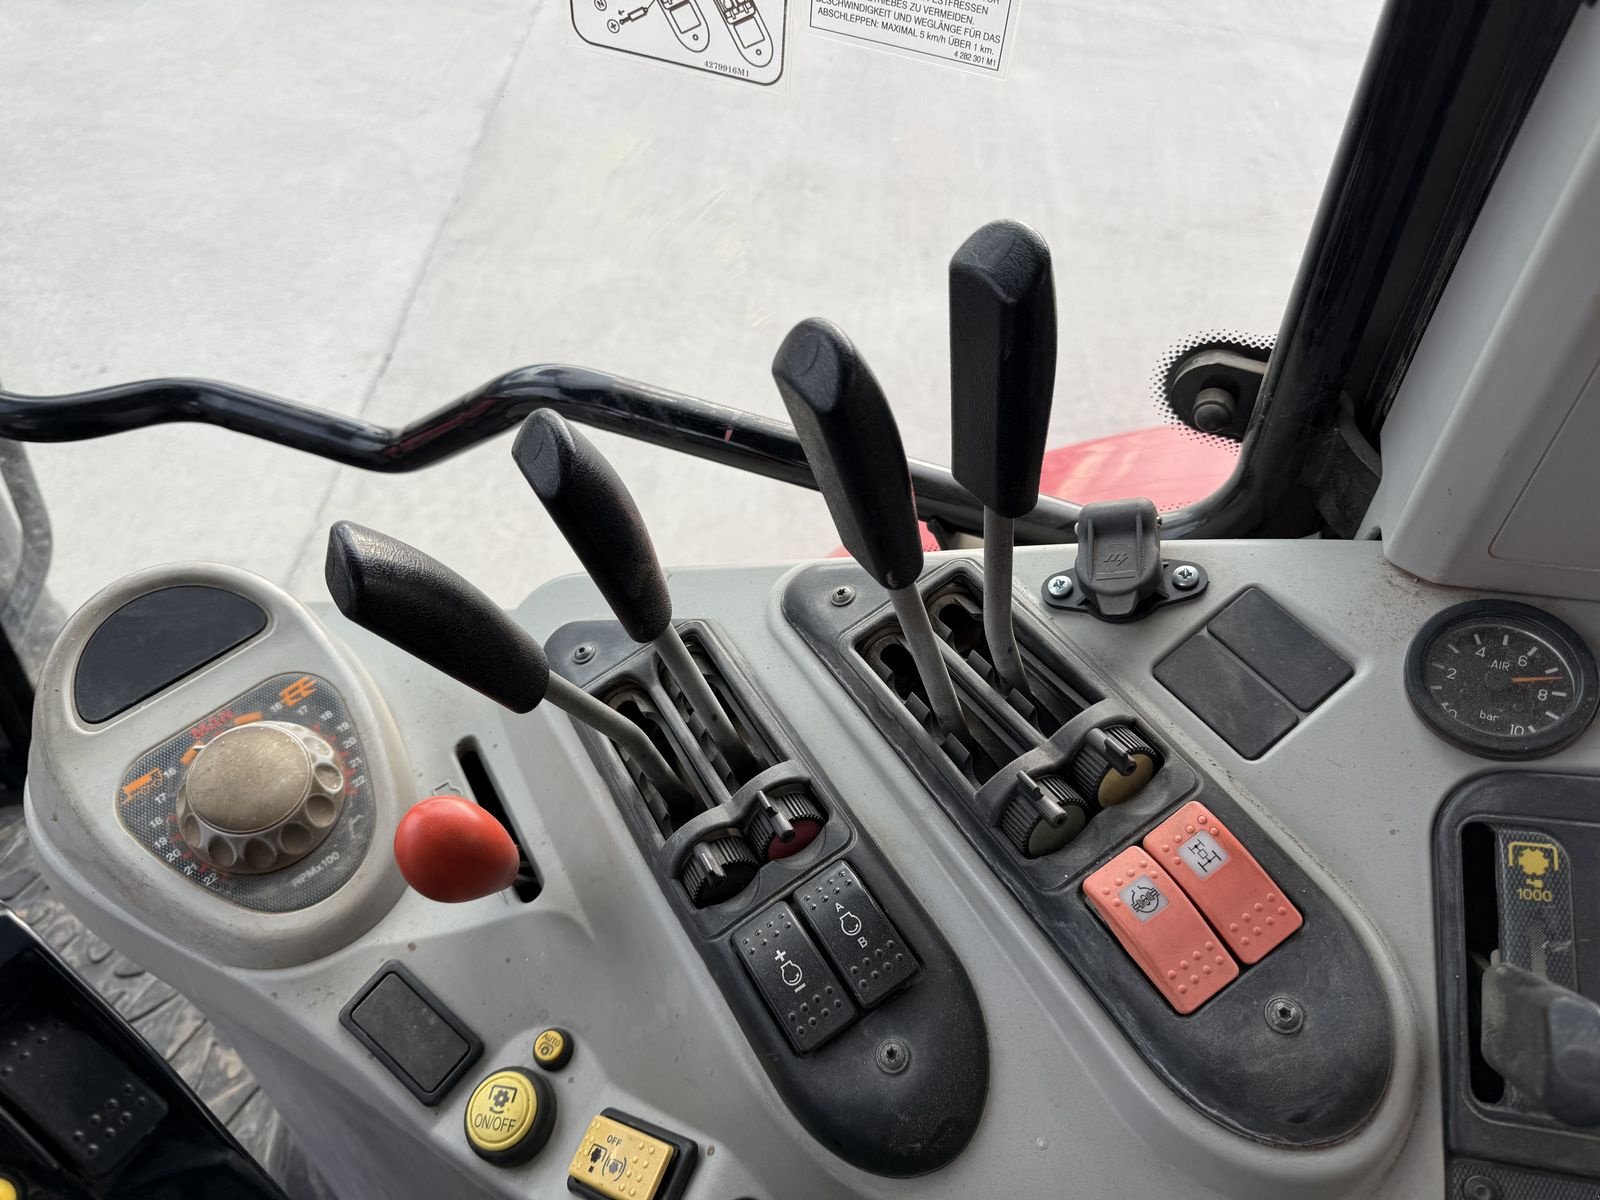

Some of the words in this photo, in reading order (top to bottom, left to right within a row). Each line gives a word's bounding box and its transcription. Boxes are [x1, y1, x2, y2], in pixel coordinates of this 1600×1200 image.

[909, 2, 921, 13] ZU
[923, 5, 975, 25] VERMEIDEN.
[815, 0, 892, 18] ESCHWINDIGKEIT
[893, 11, 912, 23] UND
[914, 15, 963, 35] WEGLÄNGE
[963, 26, 981, 40] FÜR
[983, 32, 1000, 44] DAS
[817, 6, 879, 28] ABSCHLEPPEN:
[881, 21, 918, 38] MAXIMAL
[919, 30, 925, 39] 5
[926, 31, 946, 44] km/h
[948, 35, 972, 51] ÜBER
[979, 44, 994, 55] km.
[959, 51, 972, 62] 282
[972, 54, 985, 65] 301
[1475, 646, 1486, 658] 4
[1490, 659, 1511, 672] AIR
[1517, 655, 1528, 667] 6
[1446, 667, 1457, 680] 2
[1537, 688, 1548, 702] 8
[1479, 709, 1499, 722] bar
[1509, 723, 1525, 736] 10
[165, 848, 181, 863] 20
[1516, 888, 1552, 902] 1000
[834, 901, 844, 913] A
[857, 936, 868, 949] B
[541, 1032, 561, 1048] AUTO
[474, 1113, 517, 1133] ON/OFF
[606, 1134, 623, 1147] OFF
